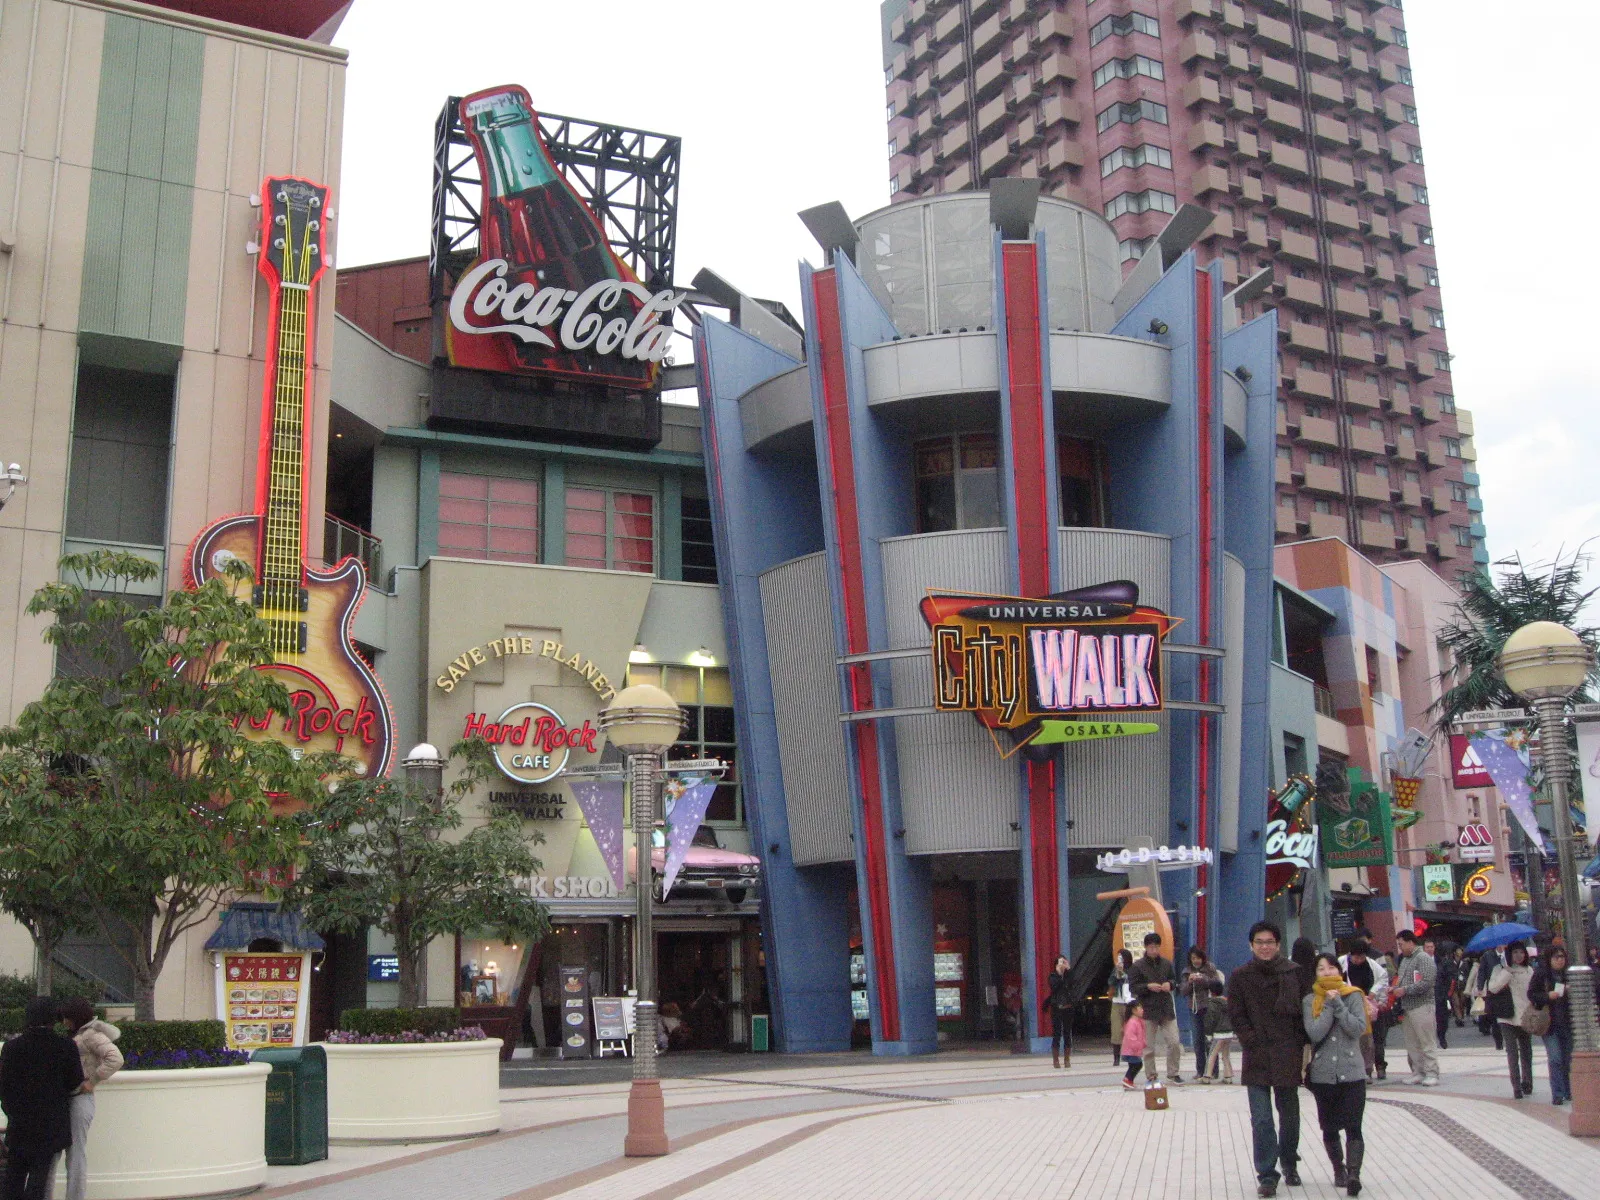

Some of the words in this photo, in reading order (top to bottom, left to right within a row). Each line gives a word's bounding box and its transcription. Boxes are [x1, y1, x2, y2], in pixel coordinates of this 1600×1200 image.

[450, 258, 687, 362] Coca-Cola
[989, 604, 1107, 618] UNIVERSAL
[436, 647, 487, 693] SAVE
[487, 637, 534, 659] THE
[539, 639, 617, 700] PLANET
[933, 625, 1022, 724] City
[1030, 629, 1160, 709] WALK
[284, 689, 376, 743] Rock
[1064, 723, 1125, 737] OSAKA
[463, 712, 530, 745] Hard
[534, 716, 597, 753] Rock
[512, 754, 550, 769] CAFE
[488, 791, 567, 805] UNIVERSAL
[1159, 845, 1171, 861] &
